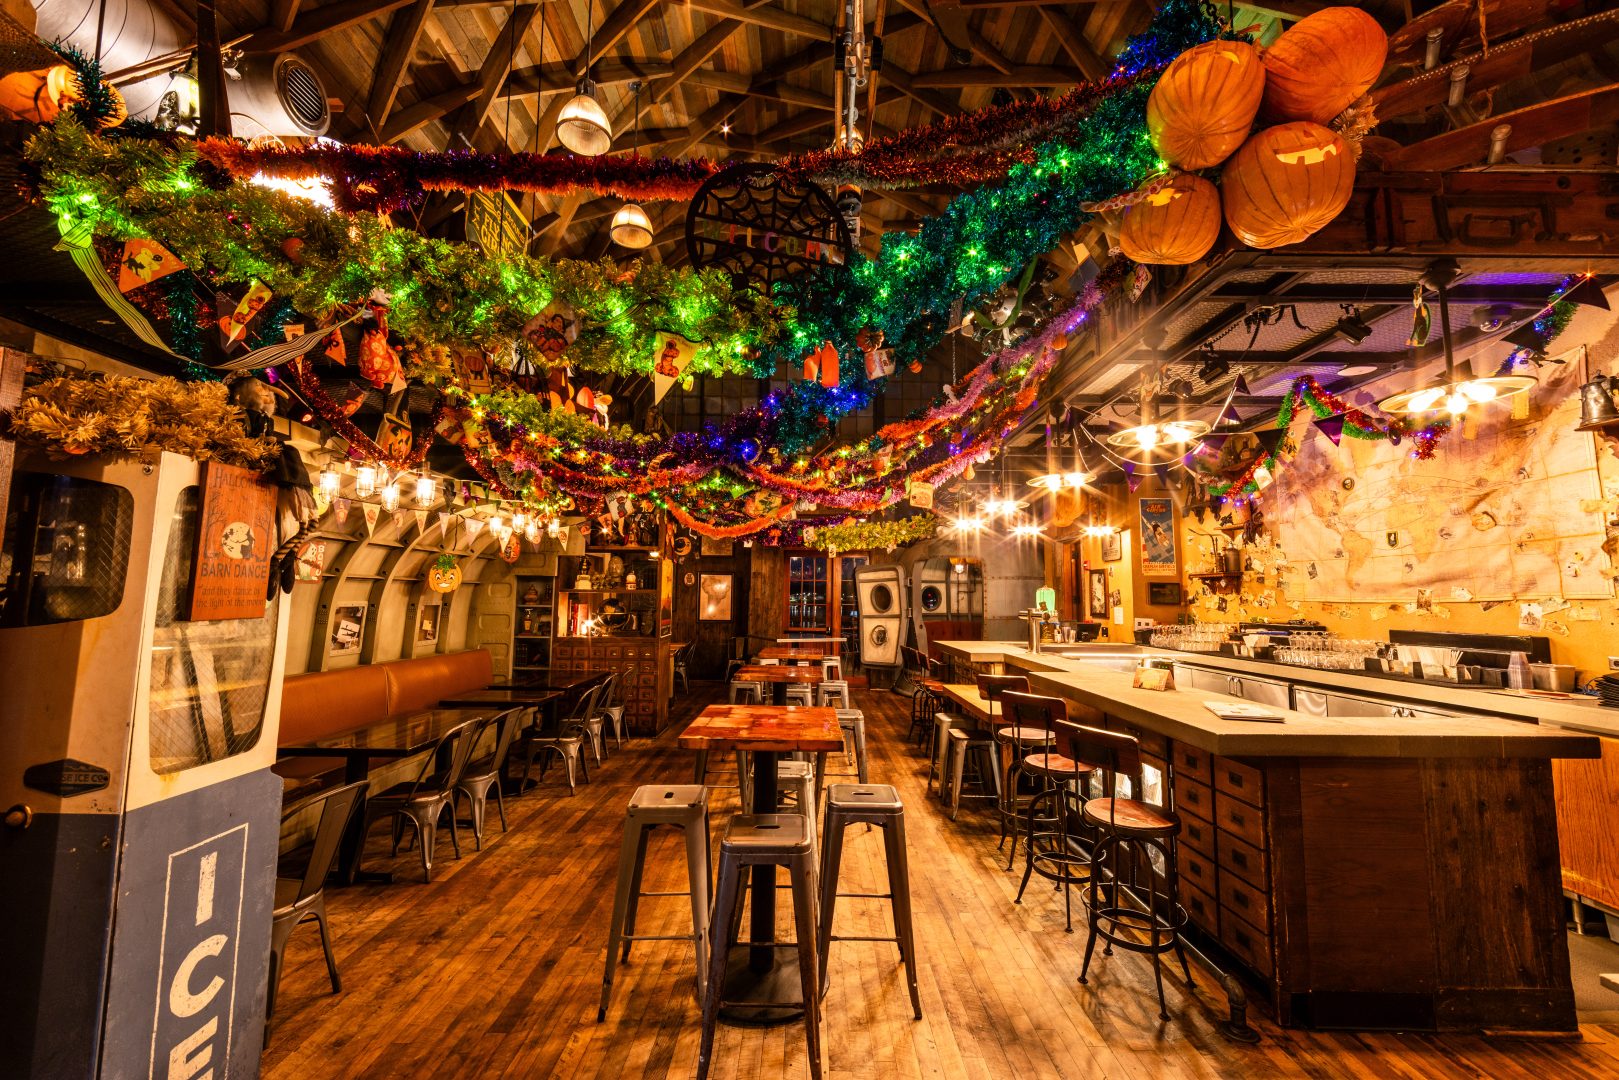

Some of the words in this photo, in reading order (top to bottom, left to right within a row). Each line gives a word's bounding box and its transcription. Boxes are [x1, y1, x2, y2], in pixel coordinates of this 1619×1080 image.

[484, 211, 514, 254] FLYNG
[201, 562, 231, 577] BARN
[233, 564, 267, 579] DANCE
[74, 774, 89, 783] ICE
